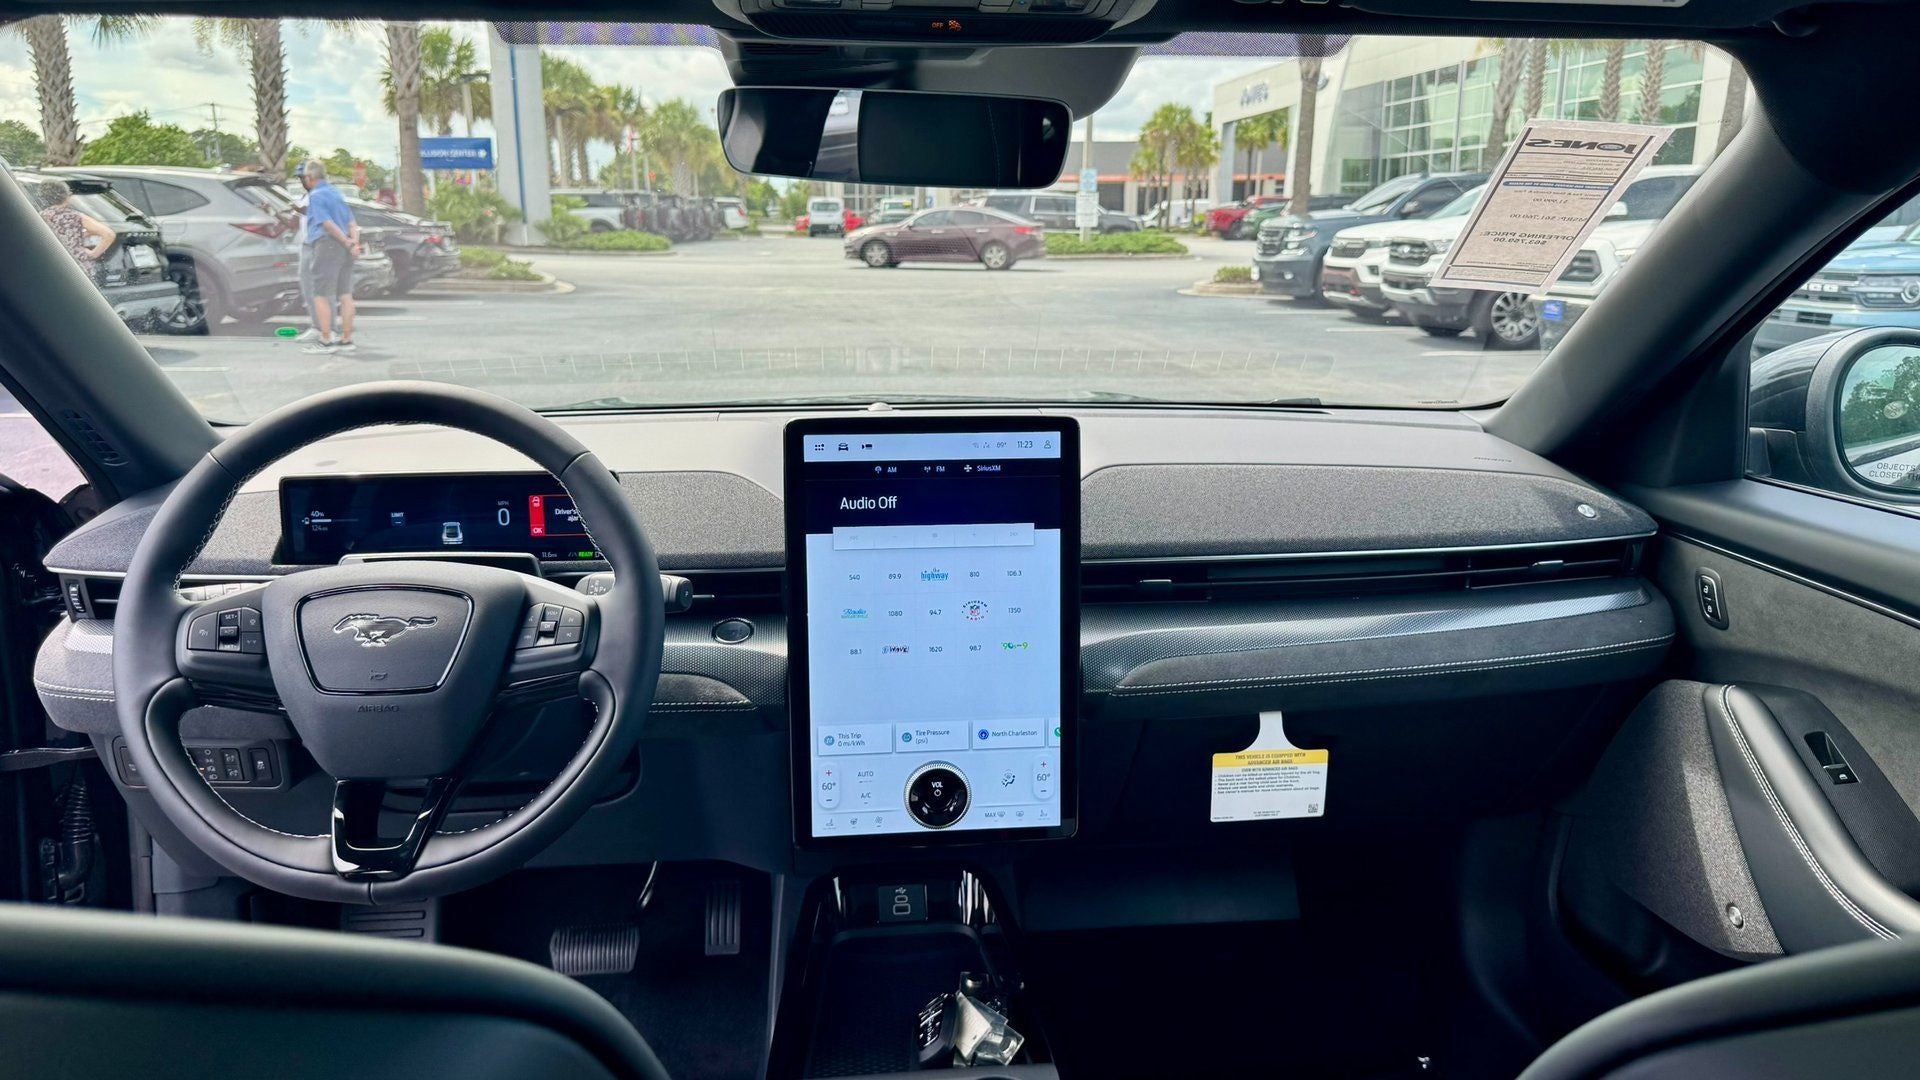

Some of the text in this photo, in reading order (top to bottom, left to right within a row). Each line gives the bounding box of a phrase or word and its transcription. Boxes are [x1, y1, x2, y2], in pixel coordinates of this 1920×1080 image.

[1877, 462, 1916, 472] OBJECTS
[1869, 470, 1903, 479] CLOSER
[840, 496, 898, 510] Audio Off
[497, 508, 511, 526] 0
[920, 570, 949, 581] highway
[357, 705, 400, 713] AIRBAG
[851, 732, 862, 740] Trip
